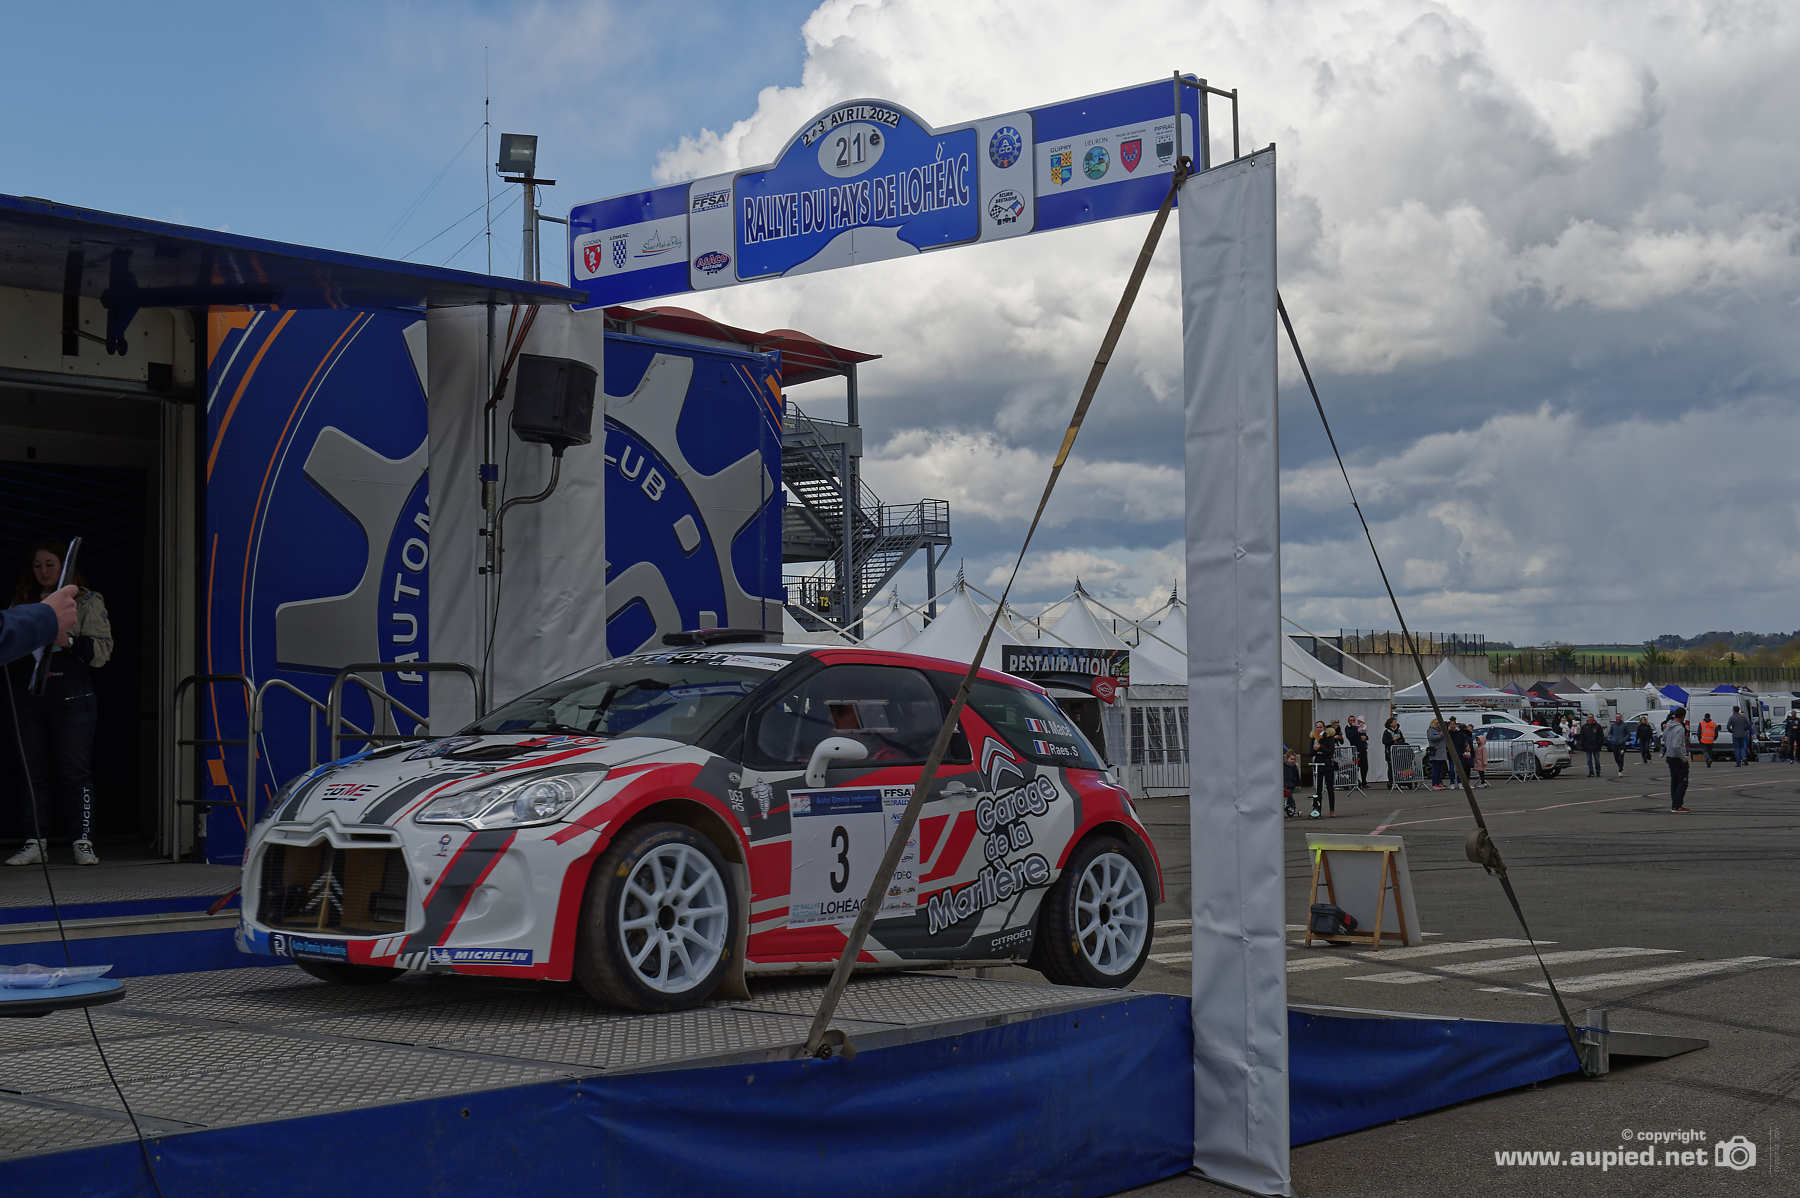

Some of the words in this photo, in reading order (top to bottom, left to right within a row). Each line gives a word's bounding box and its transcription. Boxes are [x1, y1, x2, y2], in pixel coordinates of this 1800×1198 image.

[830, 106, 867, 128] AVRIL
[868, 106, 900, 127] 2022
[692, 193, 727, 210] FFSA
[743, 192, 799, 245] RALLYE
[801, 188, 826, 235] DU
[829, 180, 871, 230] PAYS
[874, 174, 897, 221] DE
[899, 142, 969, 216] LOHÉAC
[819, 595, 830, 608] T2
[1009, 655, 1110, 677] RESTAURATION
[884, 788, 912, 797] FFSA
[976, 775, 1059, 835] Garage
[986, 832, 1009, 861] de
[1008, 821, 1033, 851] la
[830, 825, 850, 893] 3
[928, 854, 1049, 935] Marlière
[454, 950, 529, 961] MICHELIN
